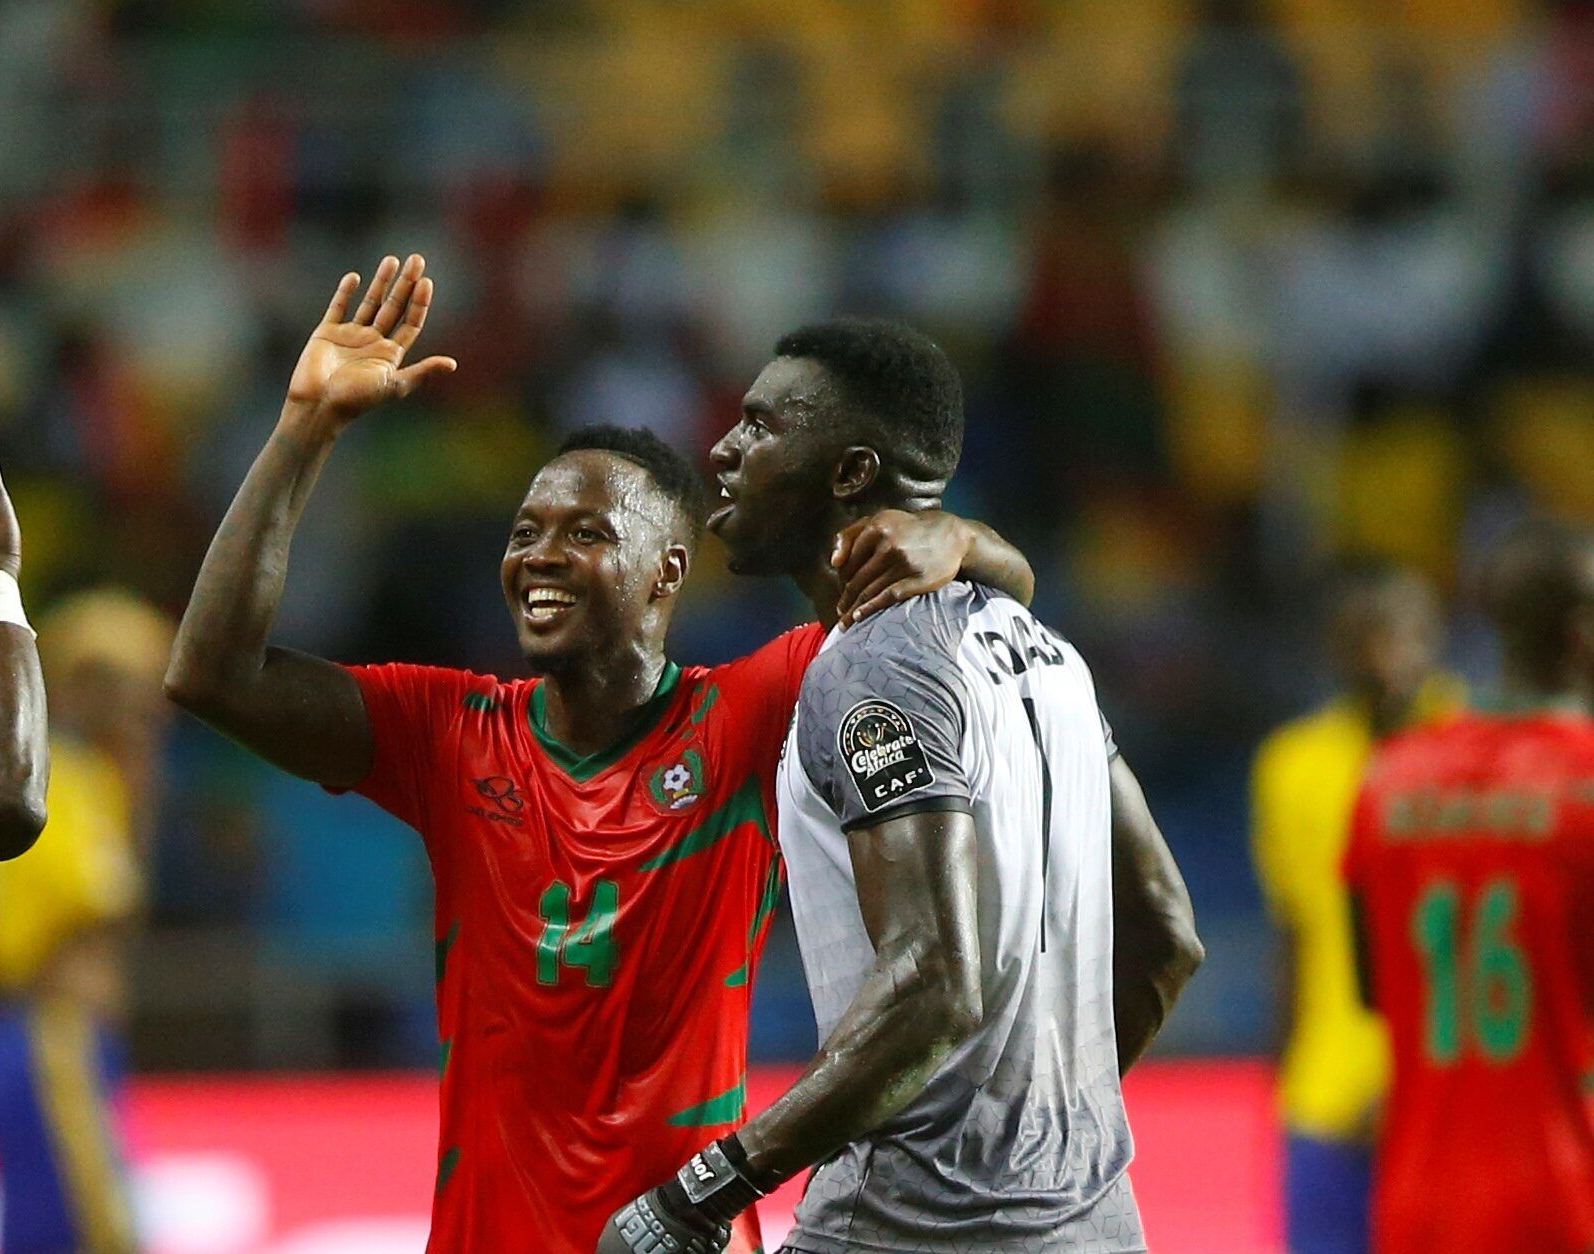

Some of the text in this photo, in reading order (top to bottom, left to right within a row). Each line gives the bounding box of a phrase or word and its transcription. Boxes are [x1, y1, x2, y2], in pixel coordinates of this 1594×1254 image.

[851, 735, 914, 774] Celebrate
[865, 749, 913, 780] Africa
[874, 770, 918, 798] CAF
[536, 879, 621, 988] 14
[1412, 877, 1533, 1064] 16
